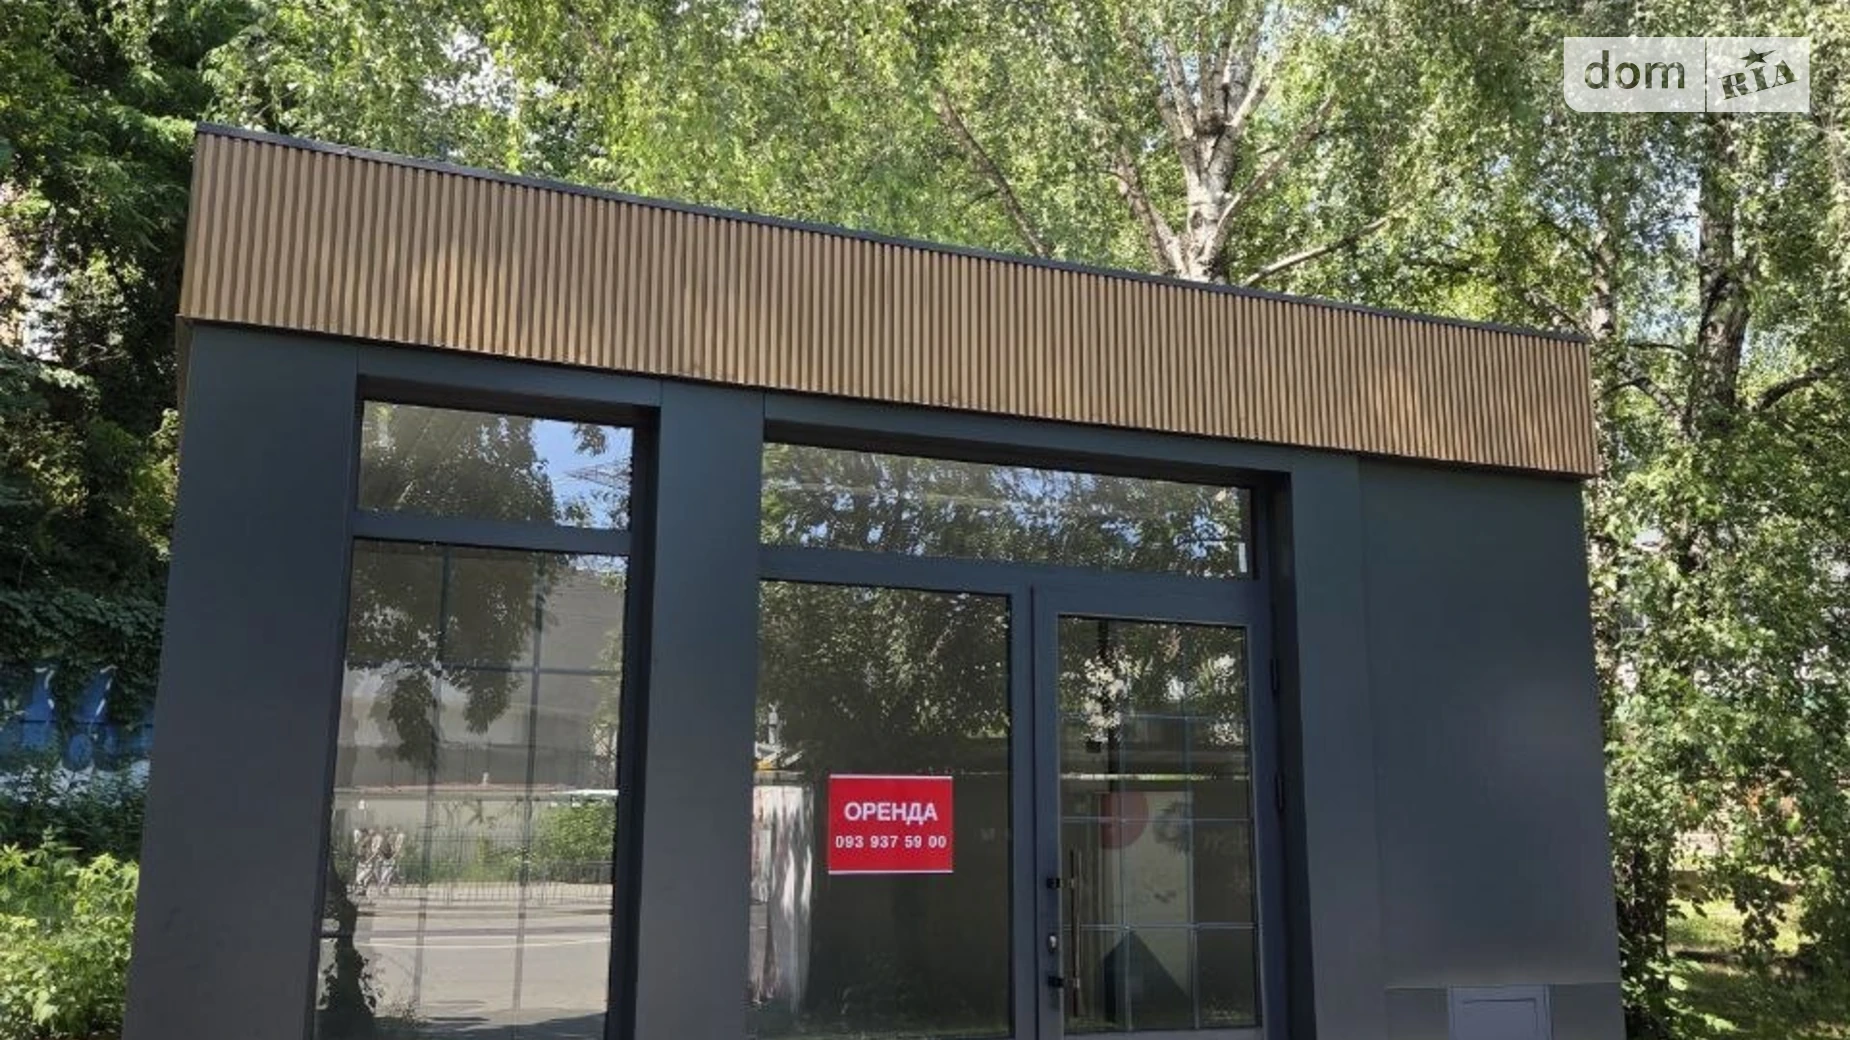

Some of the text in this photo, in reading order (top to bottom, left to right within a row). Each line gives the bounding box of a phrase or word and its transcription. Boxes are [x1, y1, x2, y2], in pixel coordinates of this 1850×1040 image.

[844, 802, 938, 825] ОРЕНДА
[835, 835, 947, 848] 093 937 59 00
